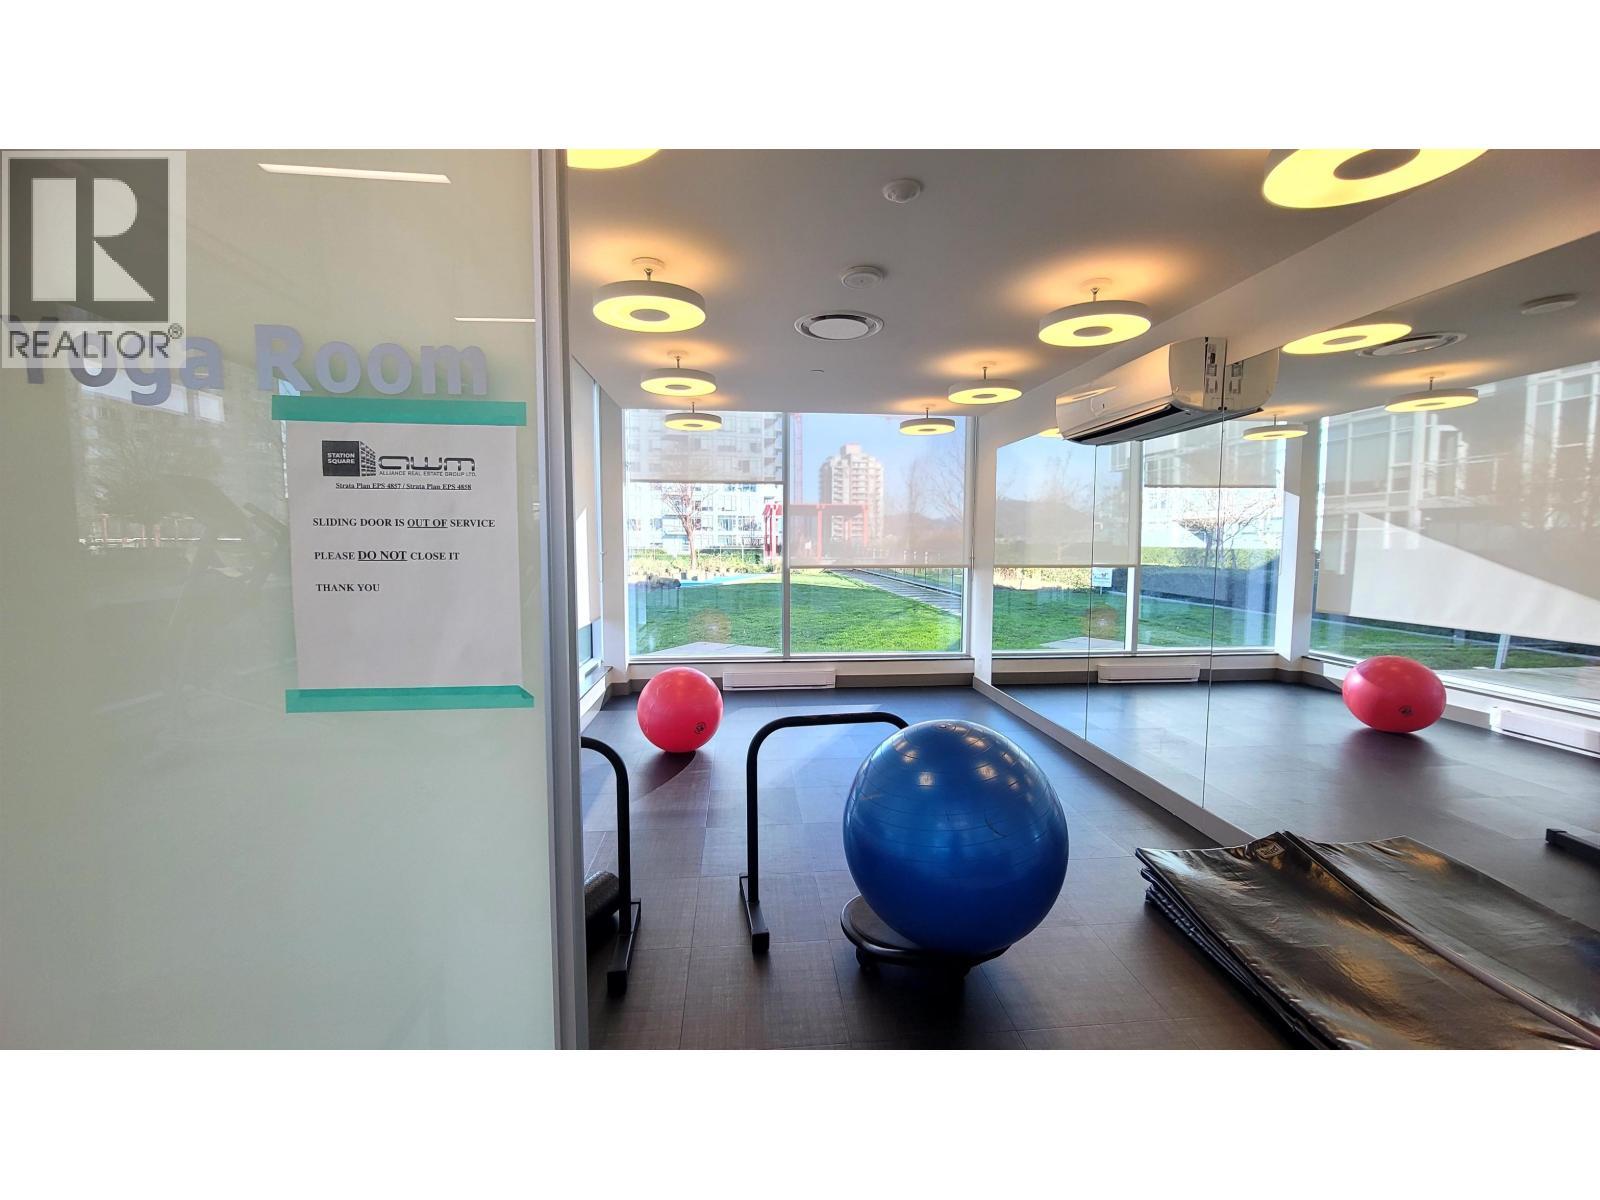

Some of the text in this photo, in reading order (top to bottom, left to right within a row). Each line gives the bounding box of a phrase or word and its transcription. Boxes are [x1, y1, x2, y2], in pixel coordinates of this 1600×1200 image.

[0, 314, 488, 406] Yoga Room
[335, 482, 355, 490] Strata
[356, 482, 371, 490] Plan
[372, 482, 386, 490] EPS
[426, 483, 441, 491] Plan
[312, 517, 496, 528] SLIDING DOOR IS OUT OF SERVICE
[314, 550, 461, 561] PLEASE DO NOT CLOSE IT
[315, 583, 380, 592] THANK YOU
